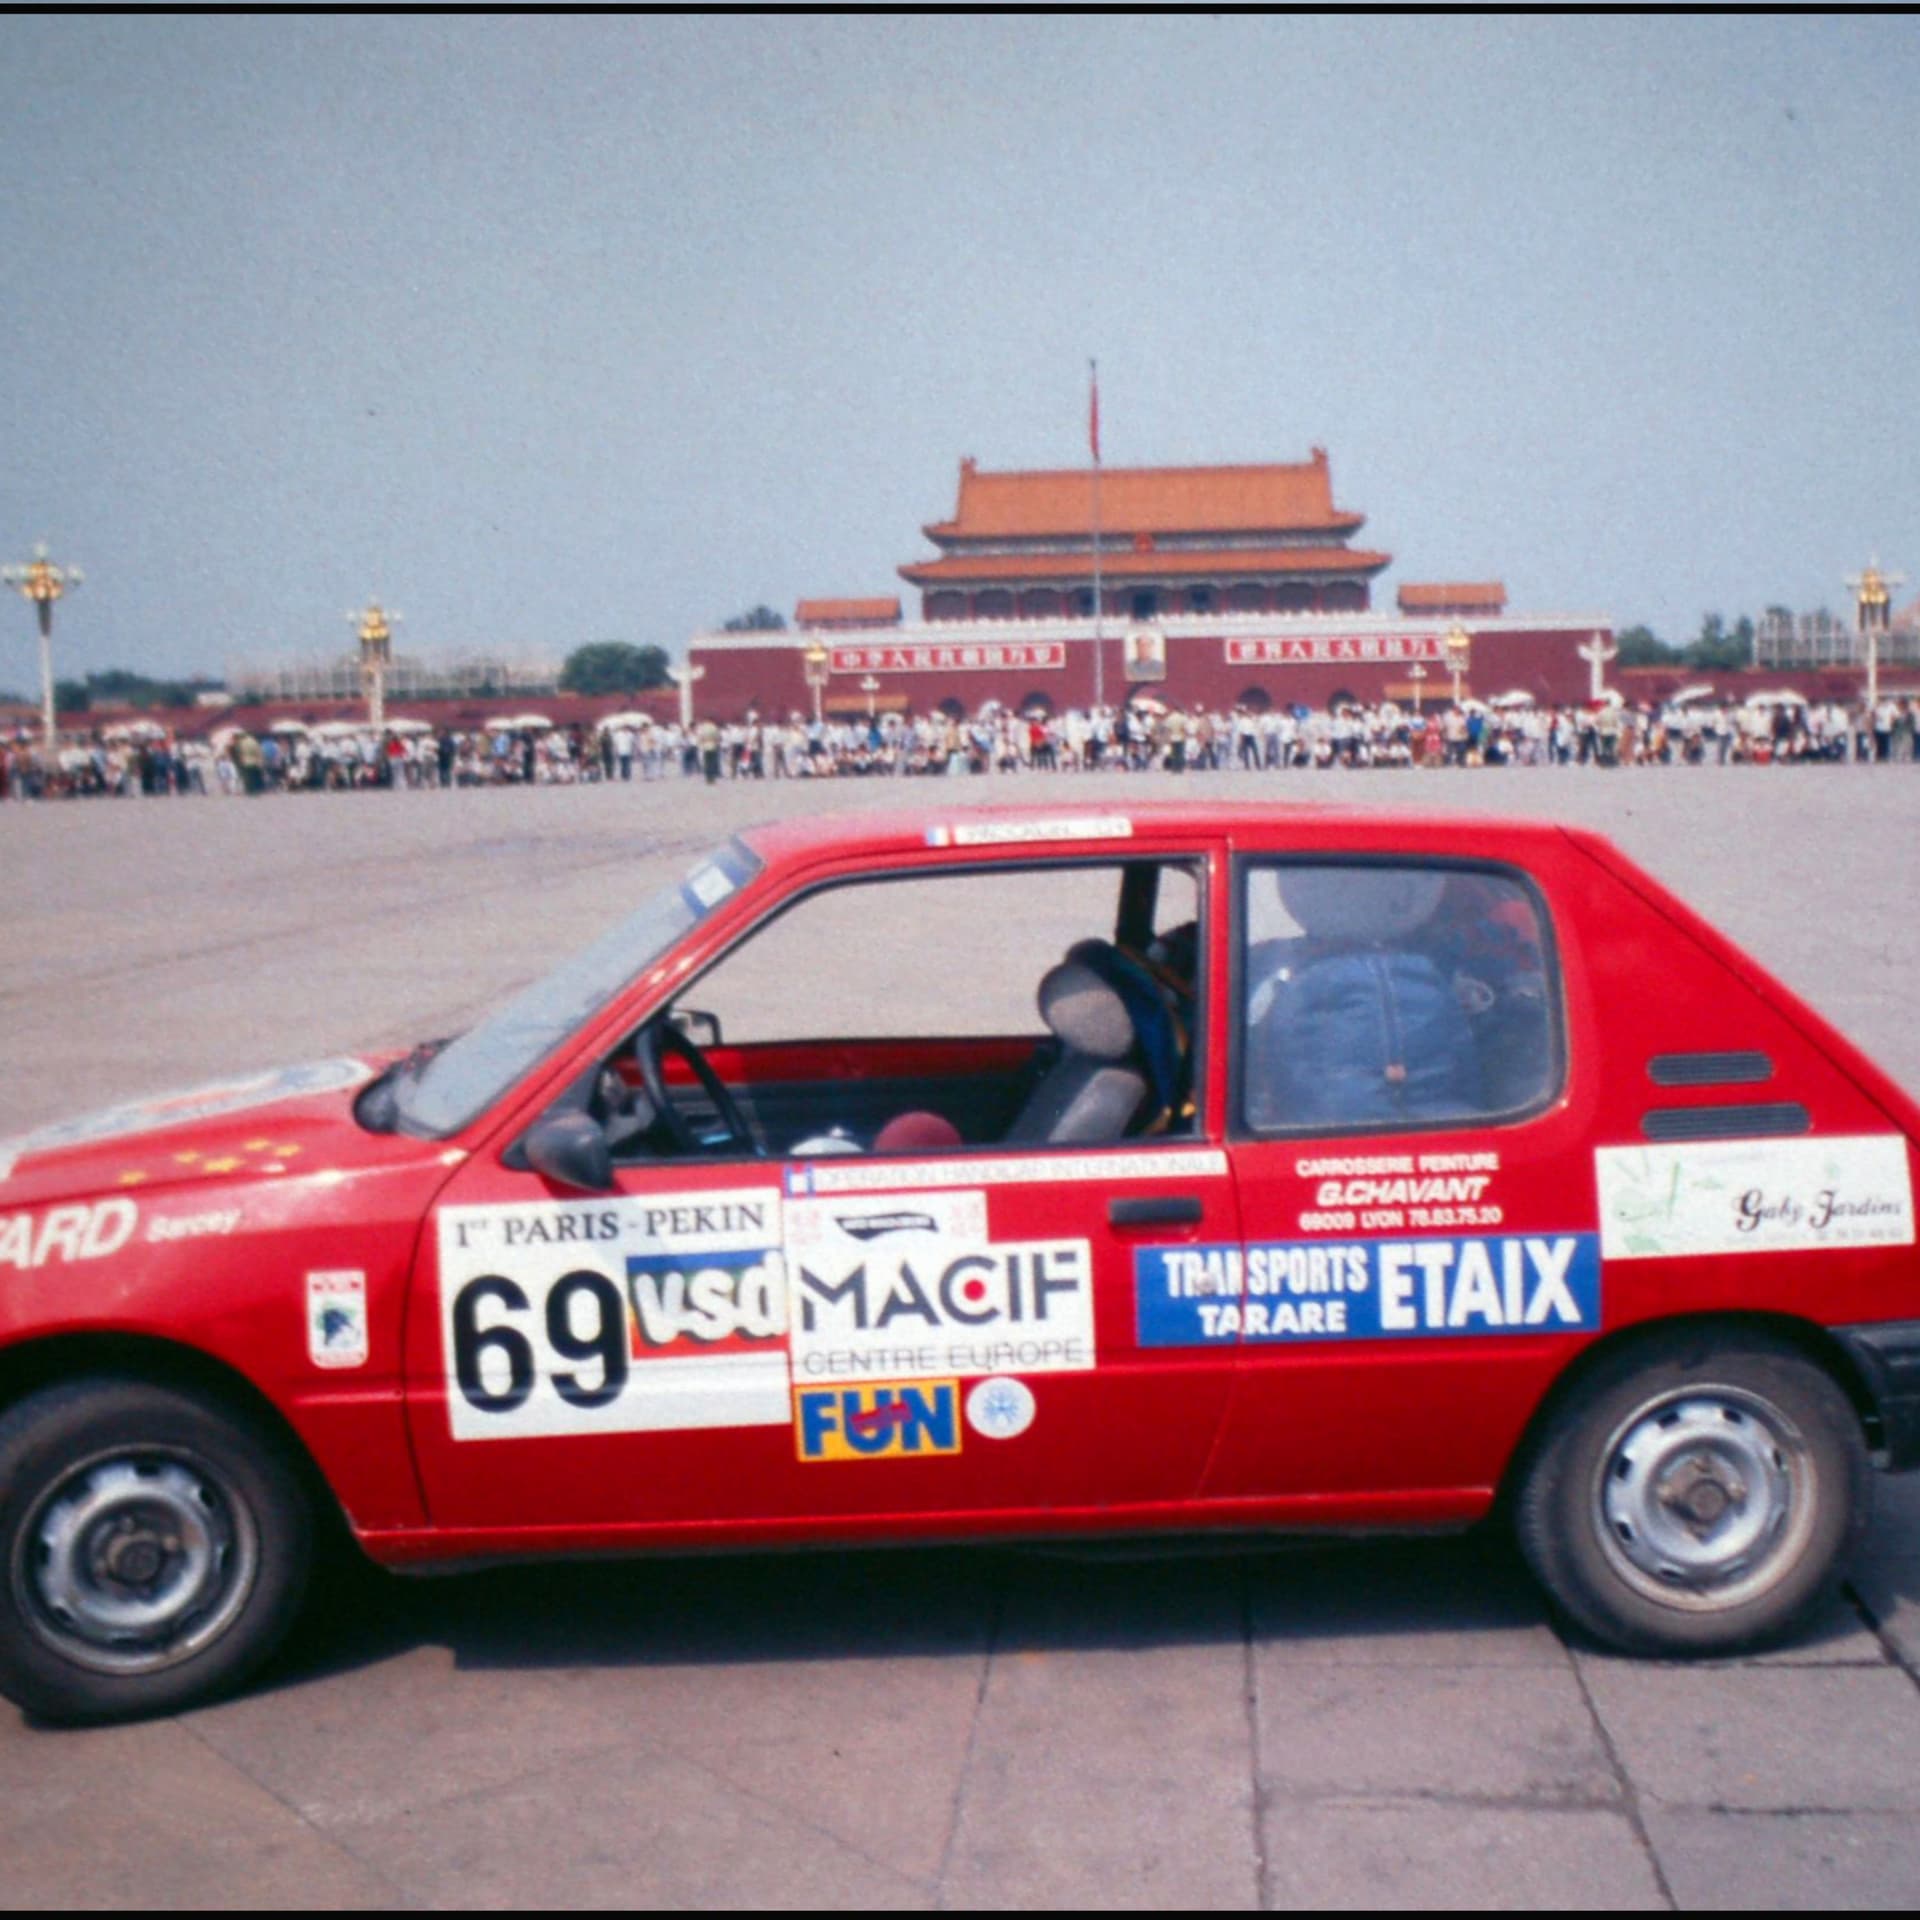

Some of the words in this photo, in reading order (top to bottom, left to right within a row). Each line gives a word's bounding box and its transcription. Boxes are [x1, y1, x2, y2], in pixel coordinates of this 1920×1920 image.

[0, 1197, 138, 1270] ARD
[503, 1211, 620, 1246] PARIS
[644, 1203, 765, 1237] PEKIN
[800, 1252, 1079, 1331] MACIF
[1162, 1244, 1369, 1298] TRANSPORTS
[1378, 1237, 1582, 1331] ETAIX
[1197, 1301, 1347, 1338] TARARE
[452, 1269, 629, 1413] 69
[802, 1348, 937, 1375] CENTRE
[950, 1337, 1084, 1369] EUROPE
[799, 1385, 957, 1457] FUN
